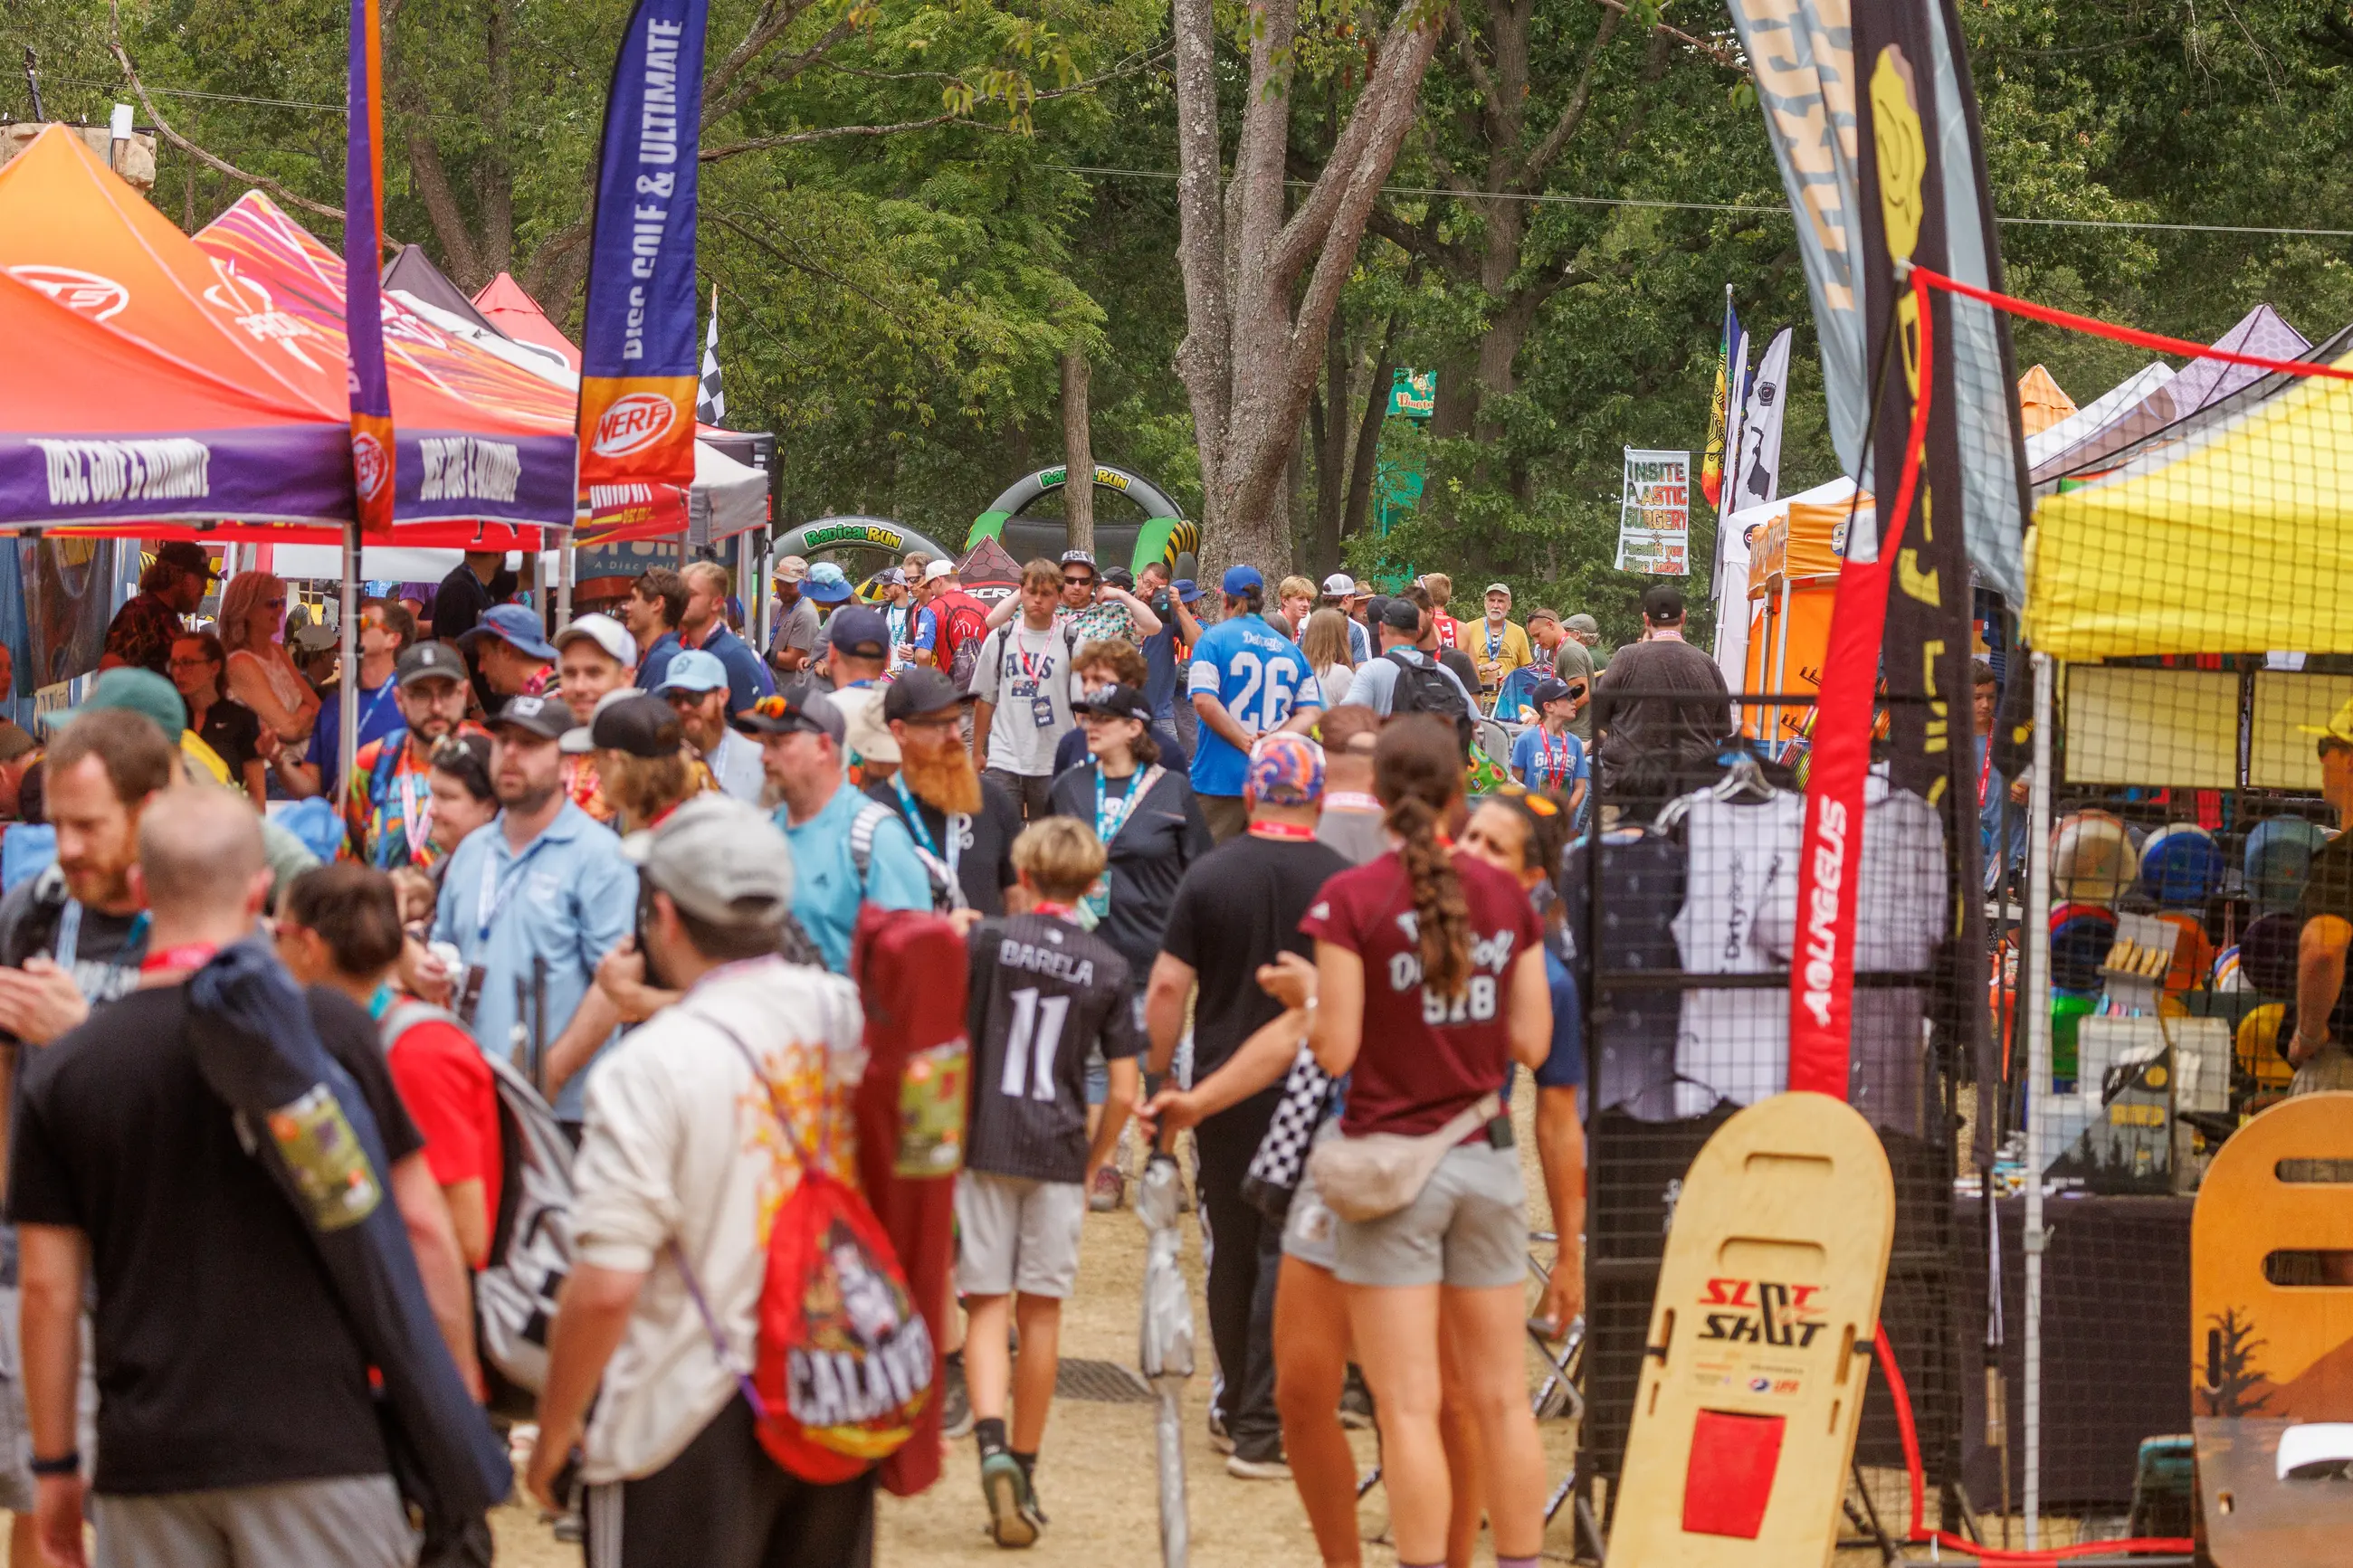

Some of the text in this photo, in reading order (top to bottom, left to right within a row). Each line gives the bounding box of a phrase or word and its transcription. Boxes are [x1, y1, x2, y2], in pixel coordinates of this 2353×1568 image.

[638, 17, 683, 165] ULTIMATE
[635, 171, 676, 198] &
[598, 403, 670, 444] NERF
[1626, 460, 1686, 482] INSITE
[1624, 506, 1688, 530] SURGERY
[1005, 651, 1055, 679] AUS
[1228, 651, 1299, 736] 26
[1000, 987, 1071, 1101] 11
